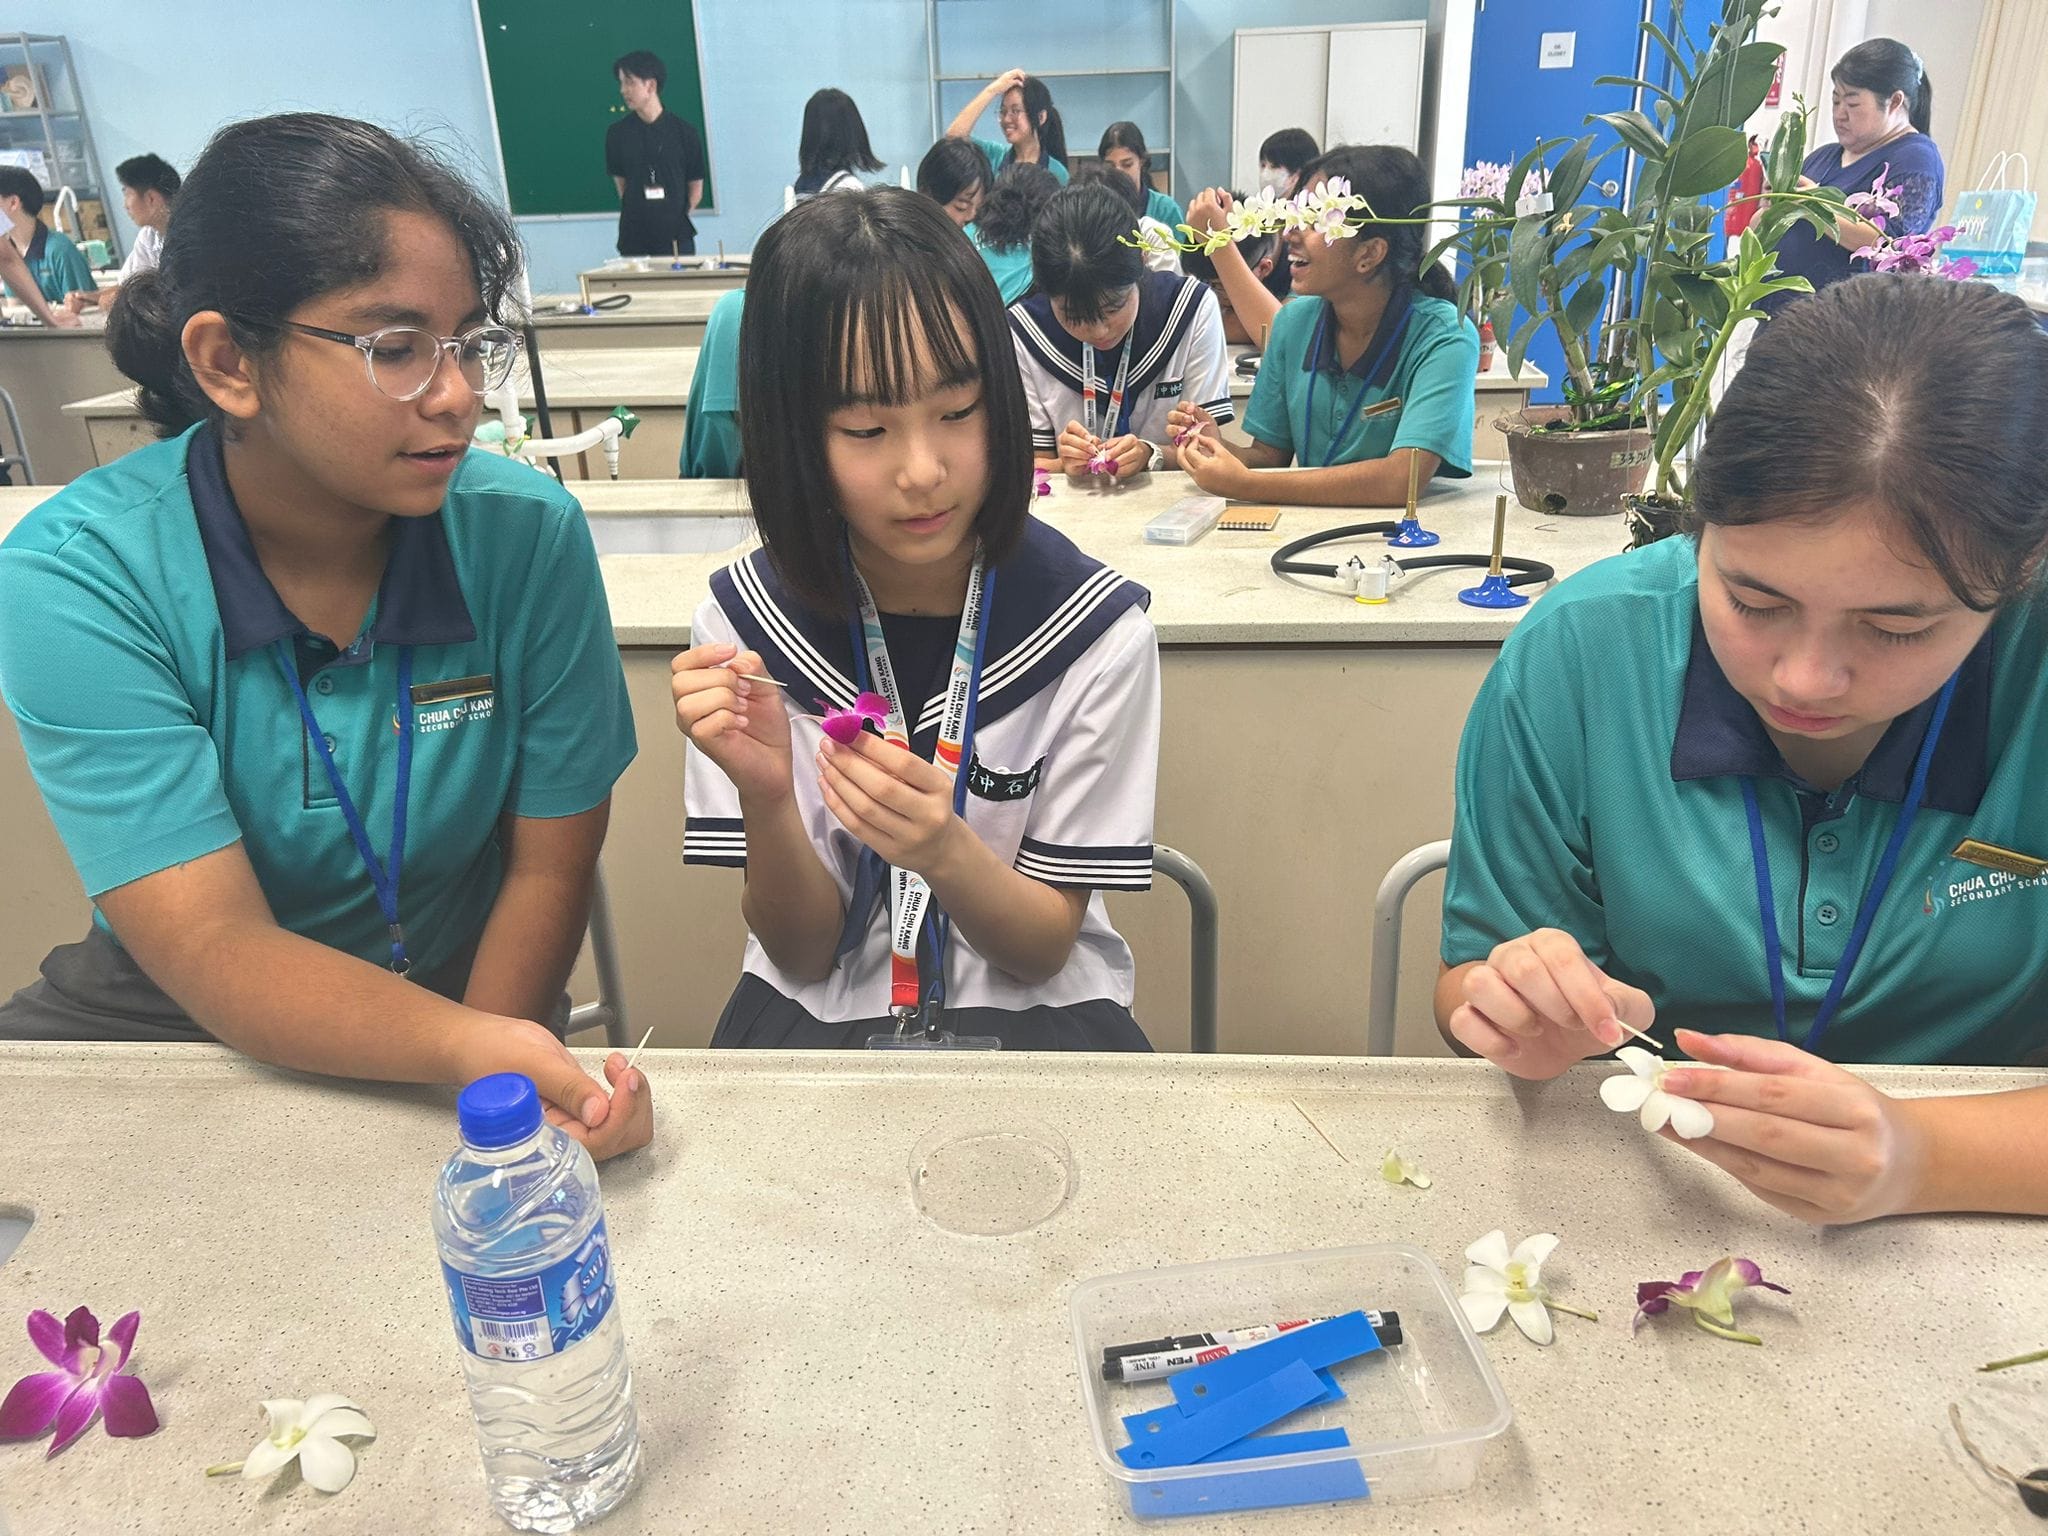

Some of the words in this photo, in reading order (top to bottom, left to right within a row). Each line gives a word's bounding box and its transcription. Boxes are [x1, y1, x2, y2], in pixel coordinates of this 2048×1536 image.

[957, 681, 968, 702] CHUA
[419, 708, 451, 725] CHUA
[471, 696, 495, 712] KAN
[953, 703, 964, 719] CHU
[949, 719, 961, 740] KANG
[1948, 876, 1986, 898] CHUA
[1950, 884, 2013, 907] SECONDARY
[2018, 877, 2048, 890] SCHO
[911, 891, 923, 912] CHUA
[906, 913, 917, 929] CHU
[902, 929, 912, 950] KANG
[1133, 1360, 1157, 1372] FINE
[1166, 1355, 1193, 1367] PEN
